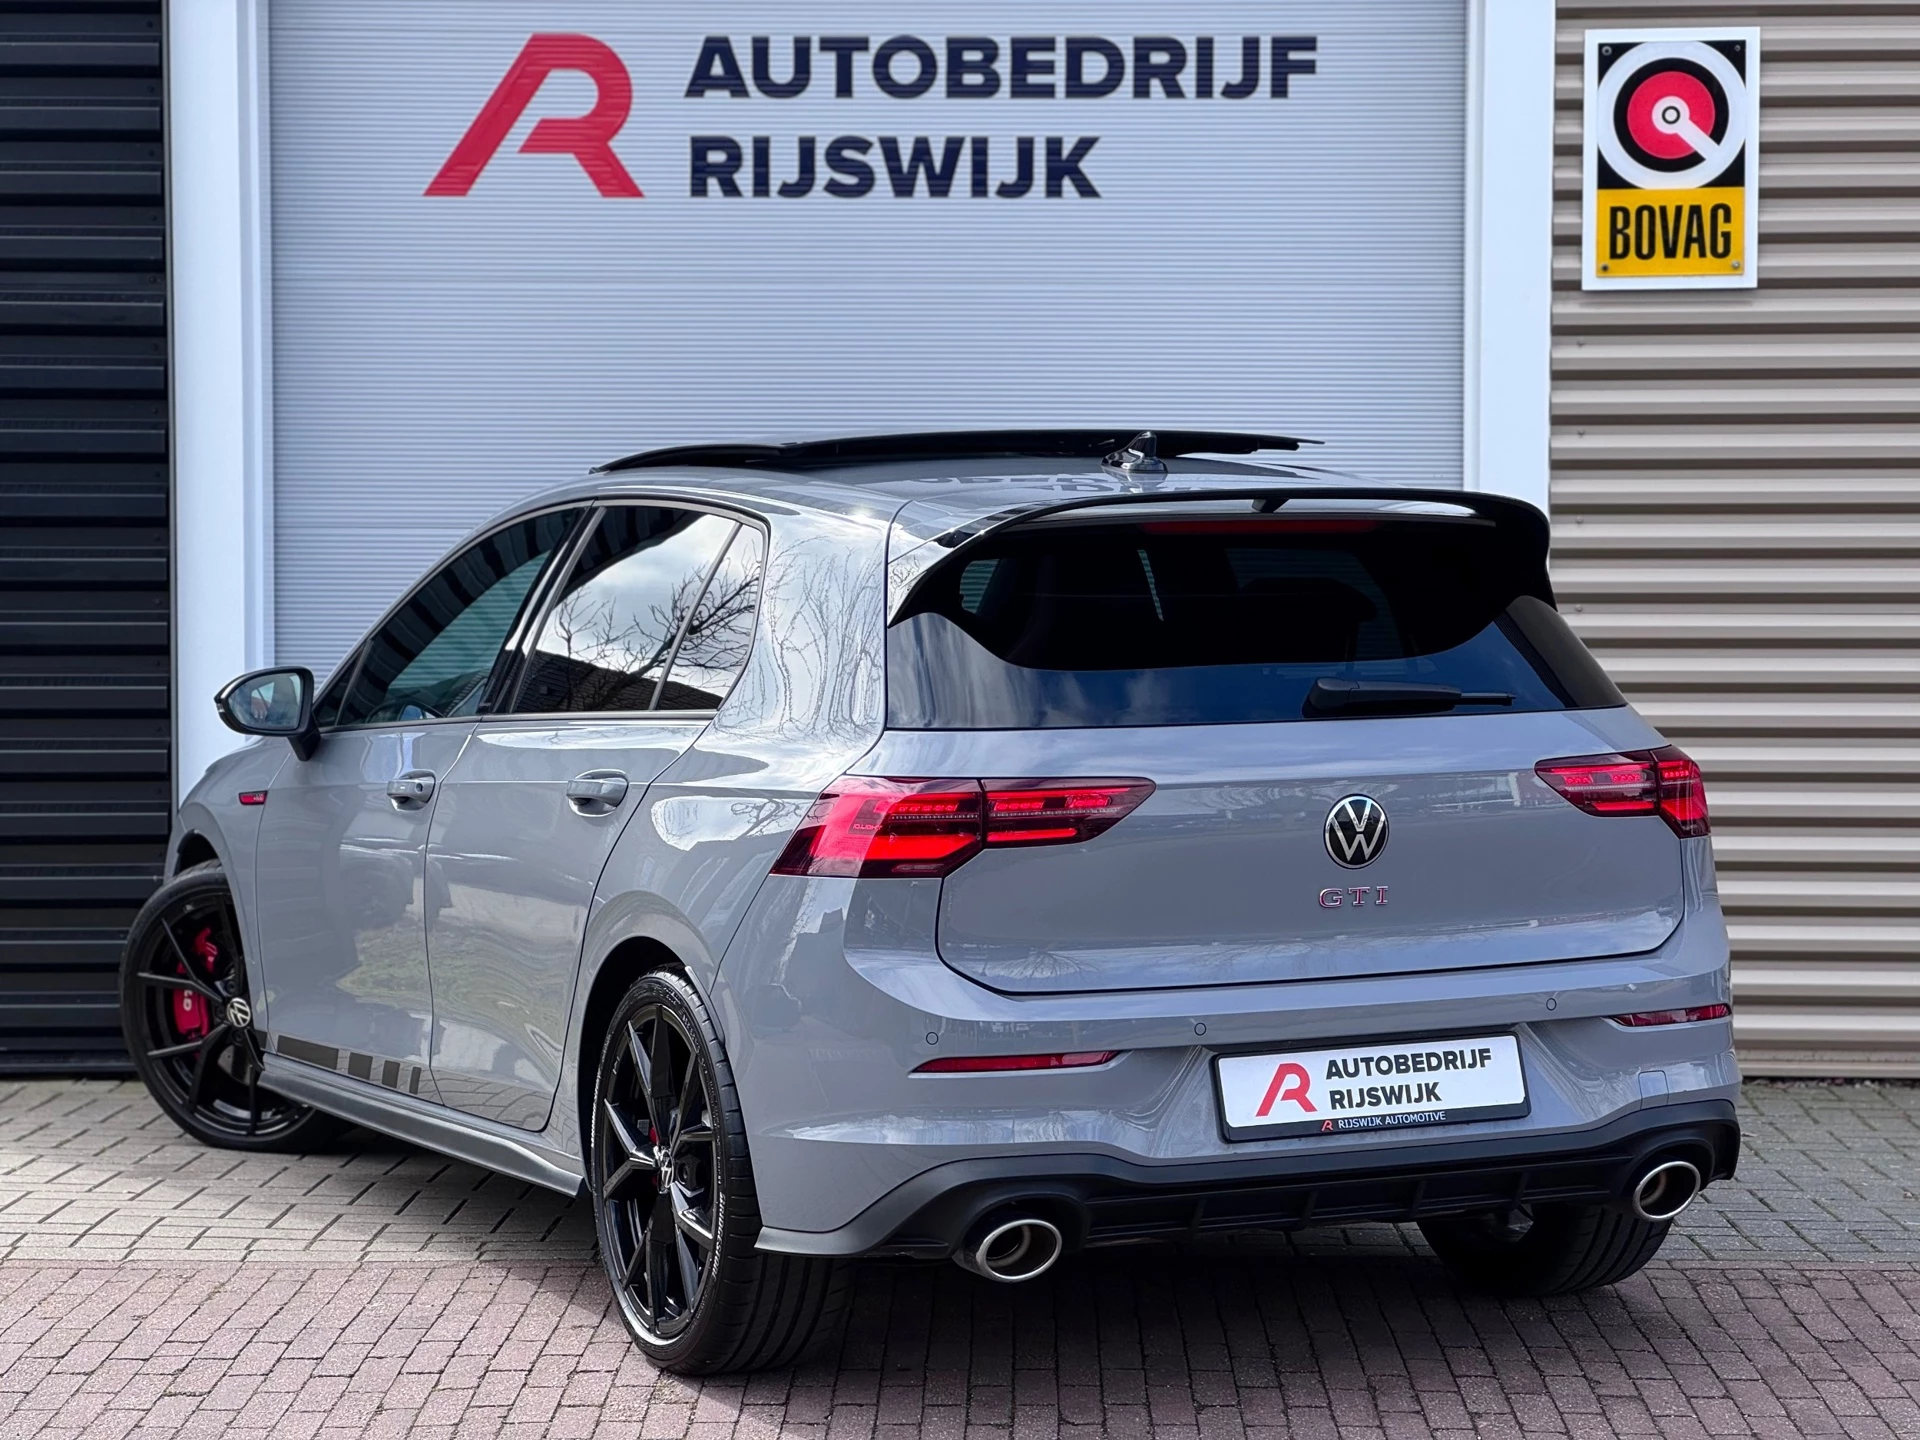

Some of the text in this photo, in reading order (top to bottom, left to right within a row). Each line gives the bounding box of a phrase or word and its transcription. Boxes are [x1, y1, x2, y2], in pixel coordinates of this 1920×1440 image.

[686, 35, 1317, 99] AUTOBEDRIJF
[690, 135, 1100, 199] RIJSWIJK
[1609, 203, 1732, 260] BOVAG
[1318, 885, 1389, 908] GTI
[1325, 1047, 1492, 1080] AUTOBEDRIJF
[1328, 1081, 1442, 1111] RIJSWIJK
[1337, 1111, 1447, 1129] RIJSWIJK AUTOMOTIVE
